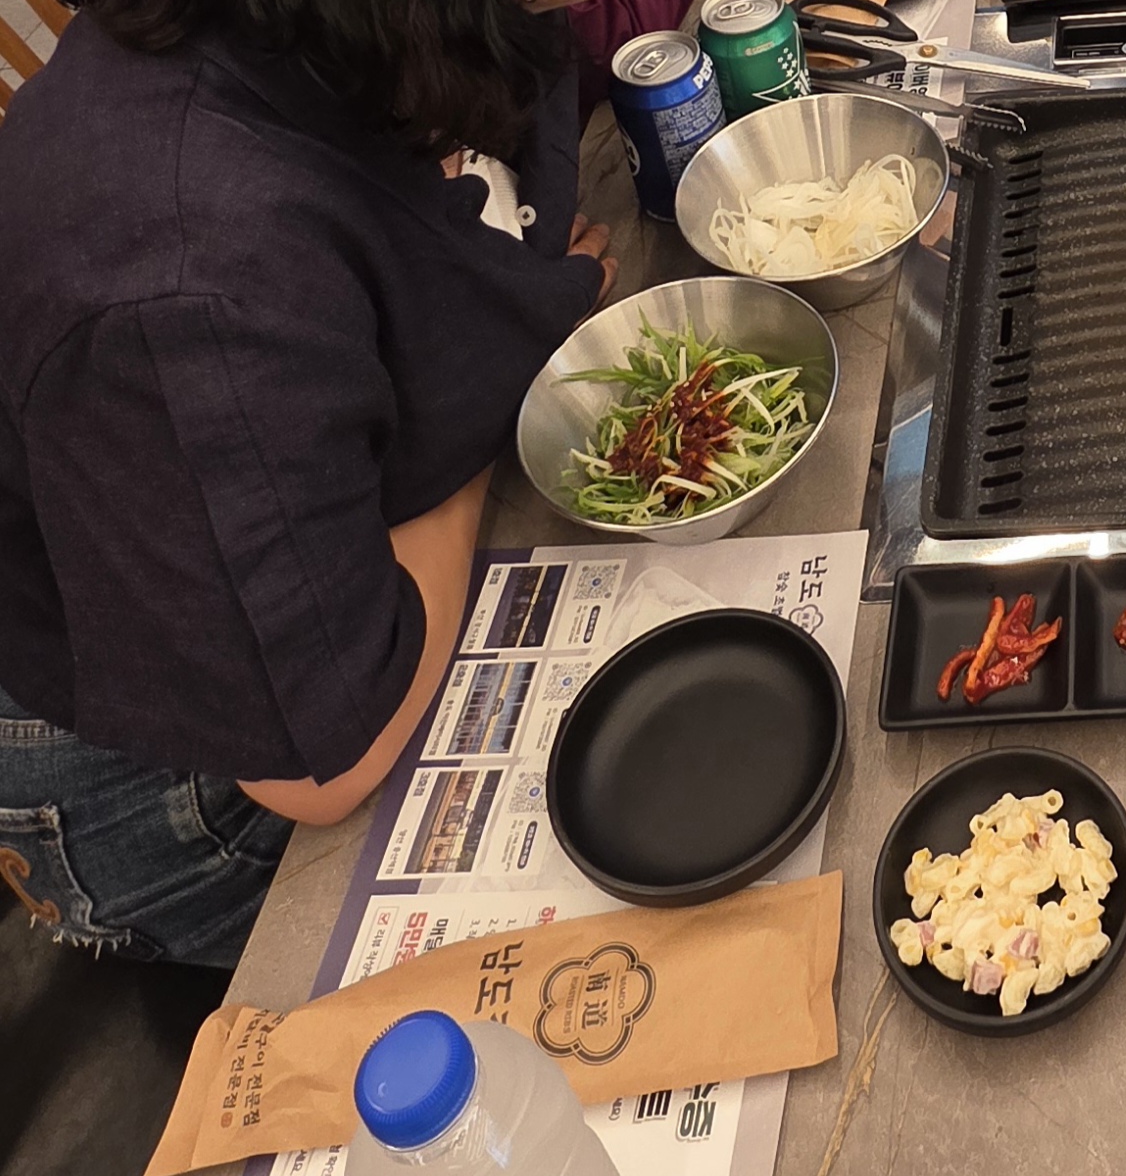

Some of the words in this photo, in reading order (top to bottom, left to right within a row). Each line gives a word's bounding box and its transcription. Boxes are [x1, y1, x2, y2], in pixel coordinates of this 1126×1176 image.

[799, 555, 828, 603] 남도
[474, 929, 525, 1025] 남도
[222, 1055, 246, 1109] 전문점
[244, 1074, 263, 1126] 전문점
